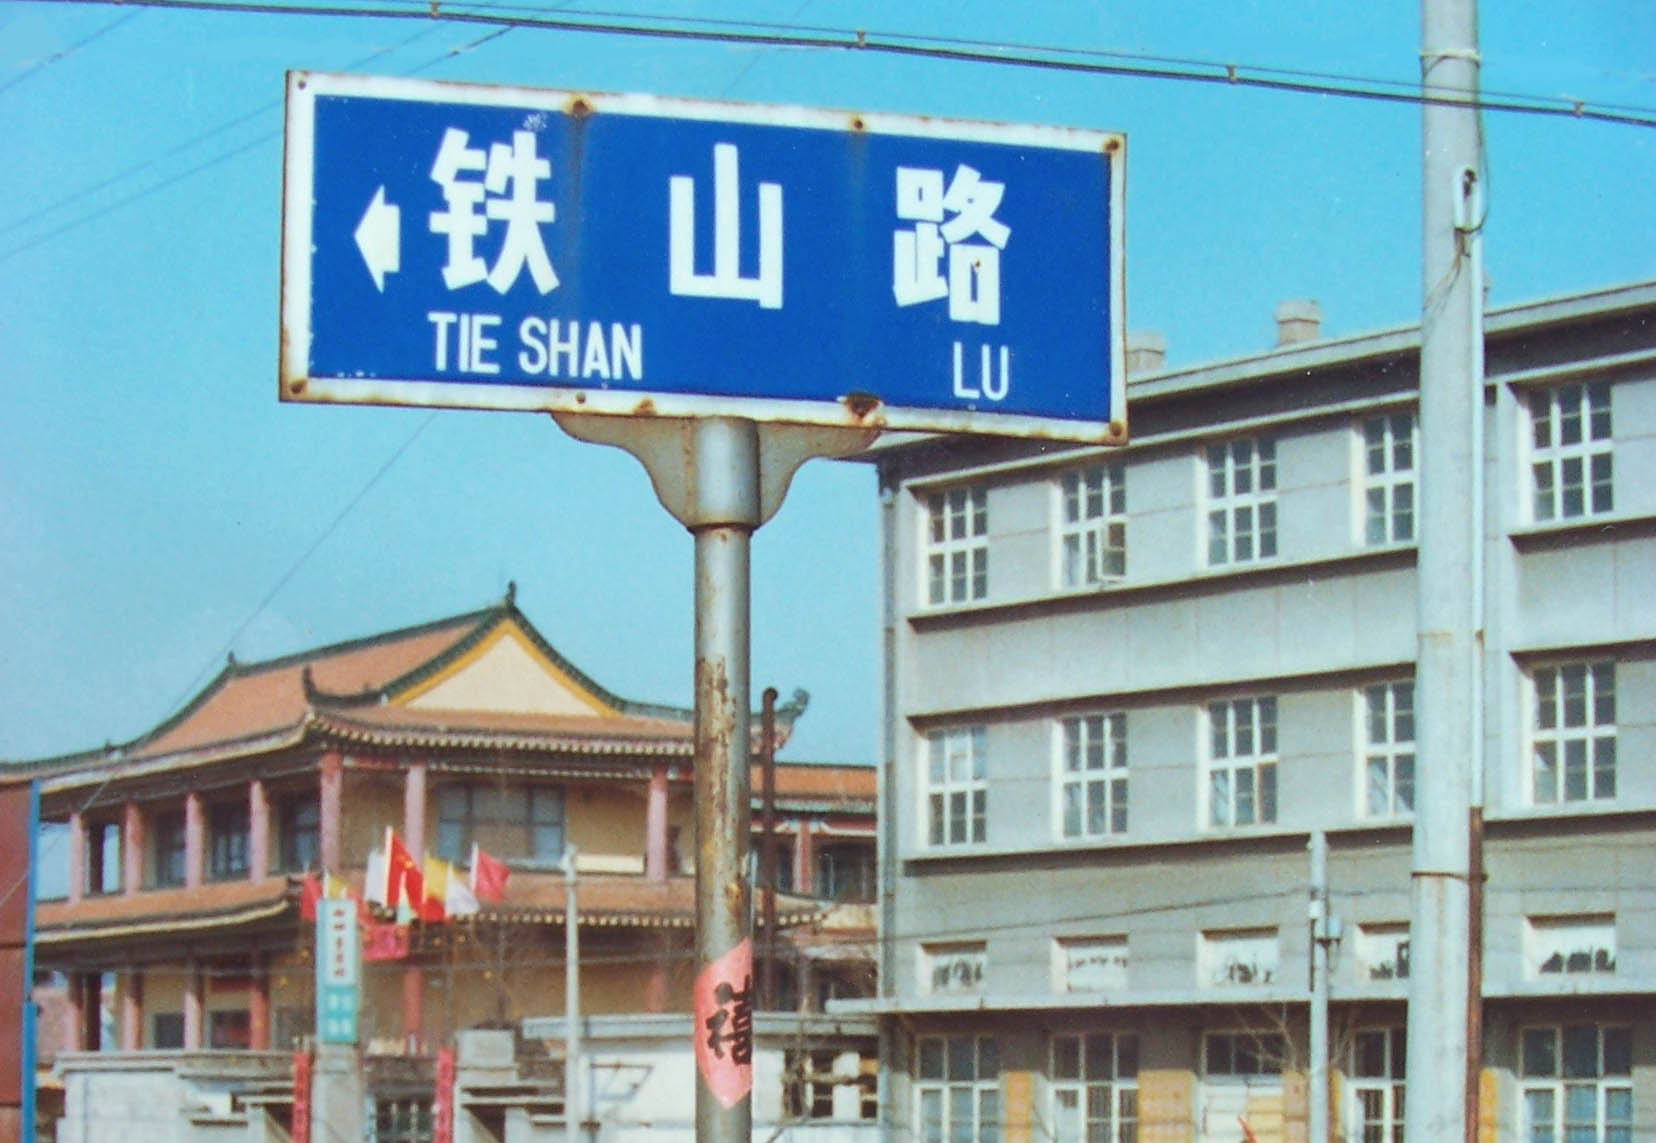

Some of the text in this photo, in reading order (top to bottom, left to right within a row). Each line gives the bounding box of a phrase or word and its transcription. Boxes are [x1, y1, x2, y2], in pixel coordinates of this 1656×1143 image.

[429, 128, 1010, 324] 铁山路
[428, 312, 1009, 400] TIE SHAN LU
